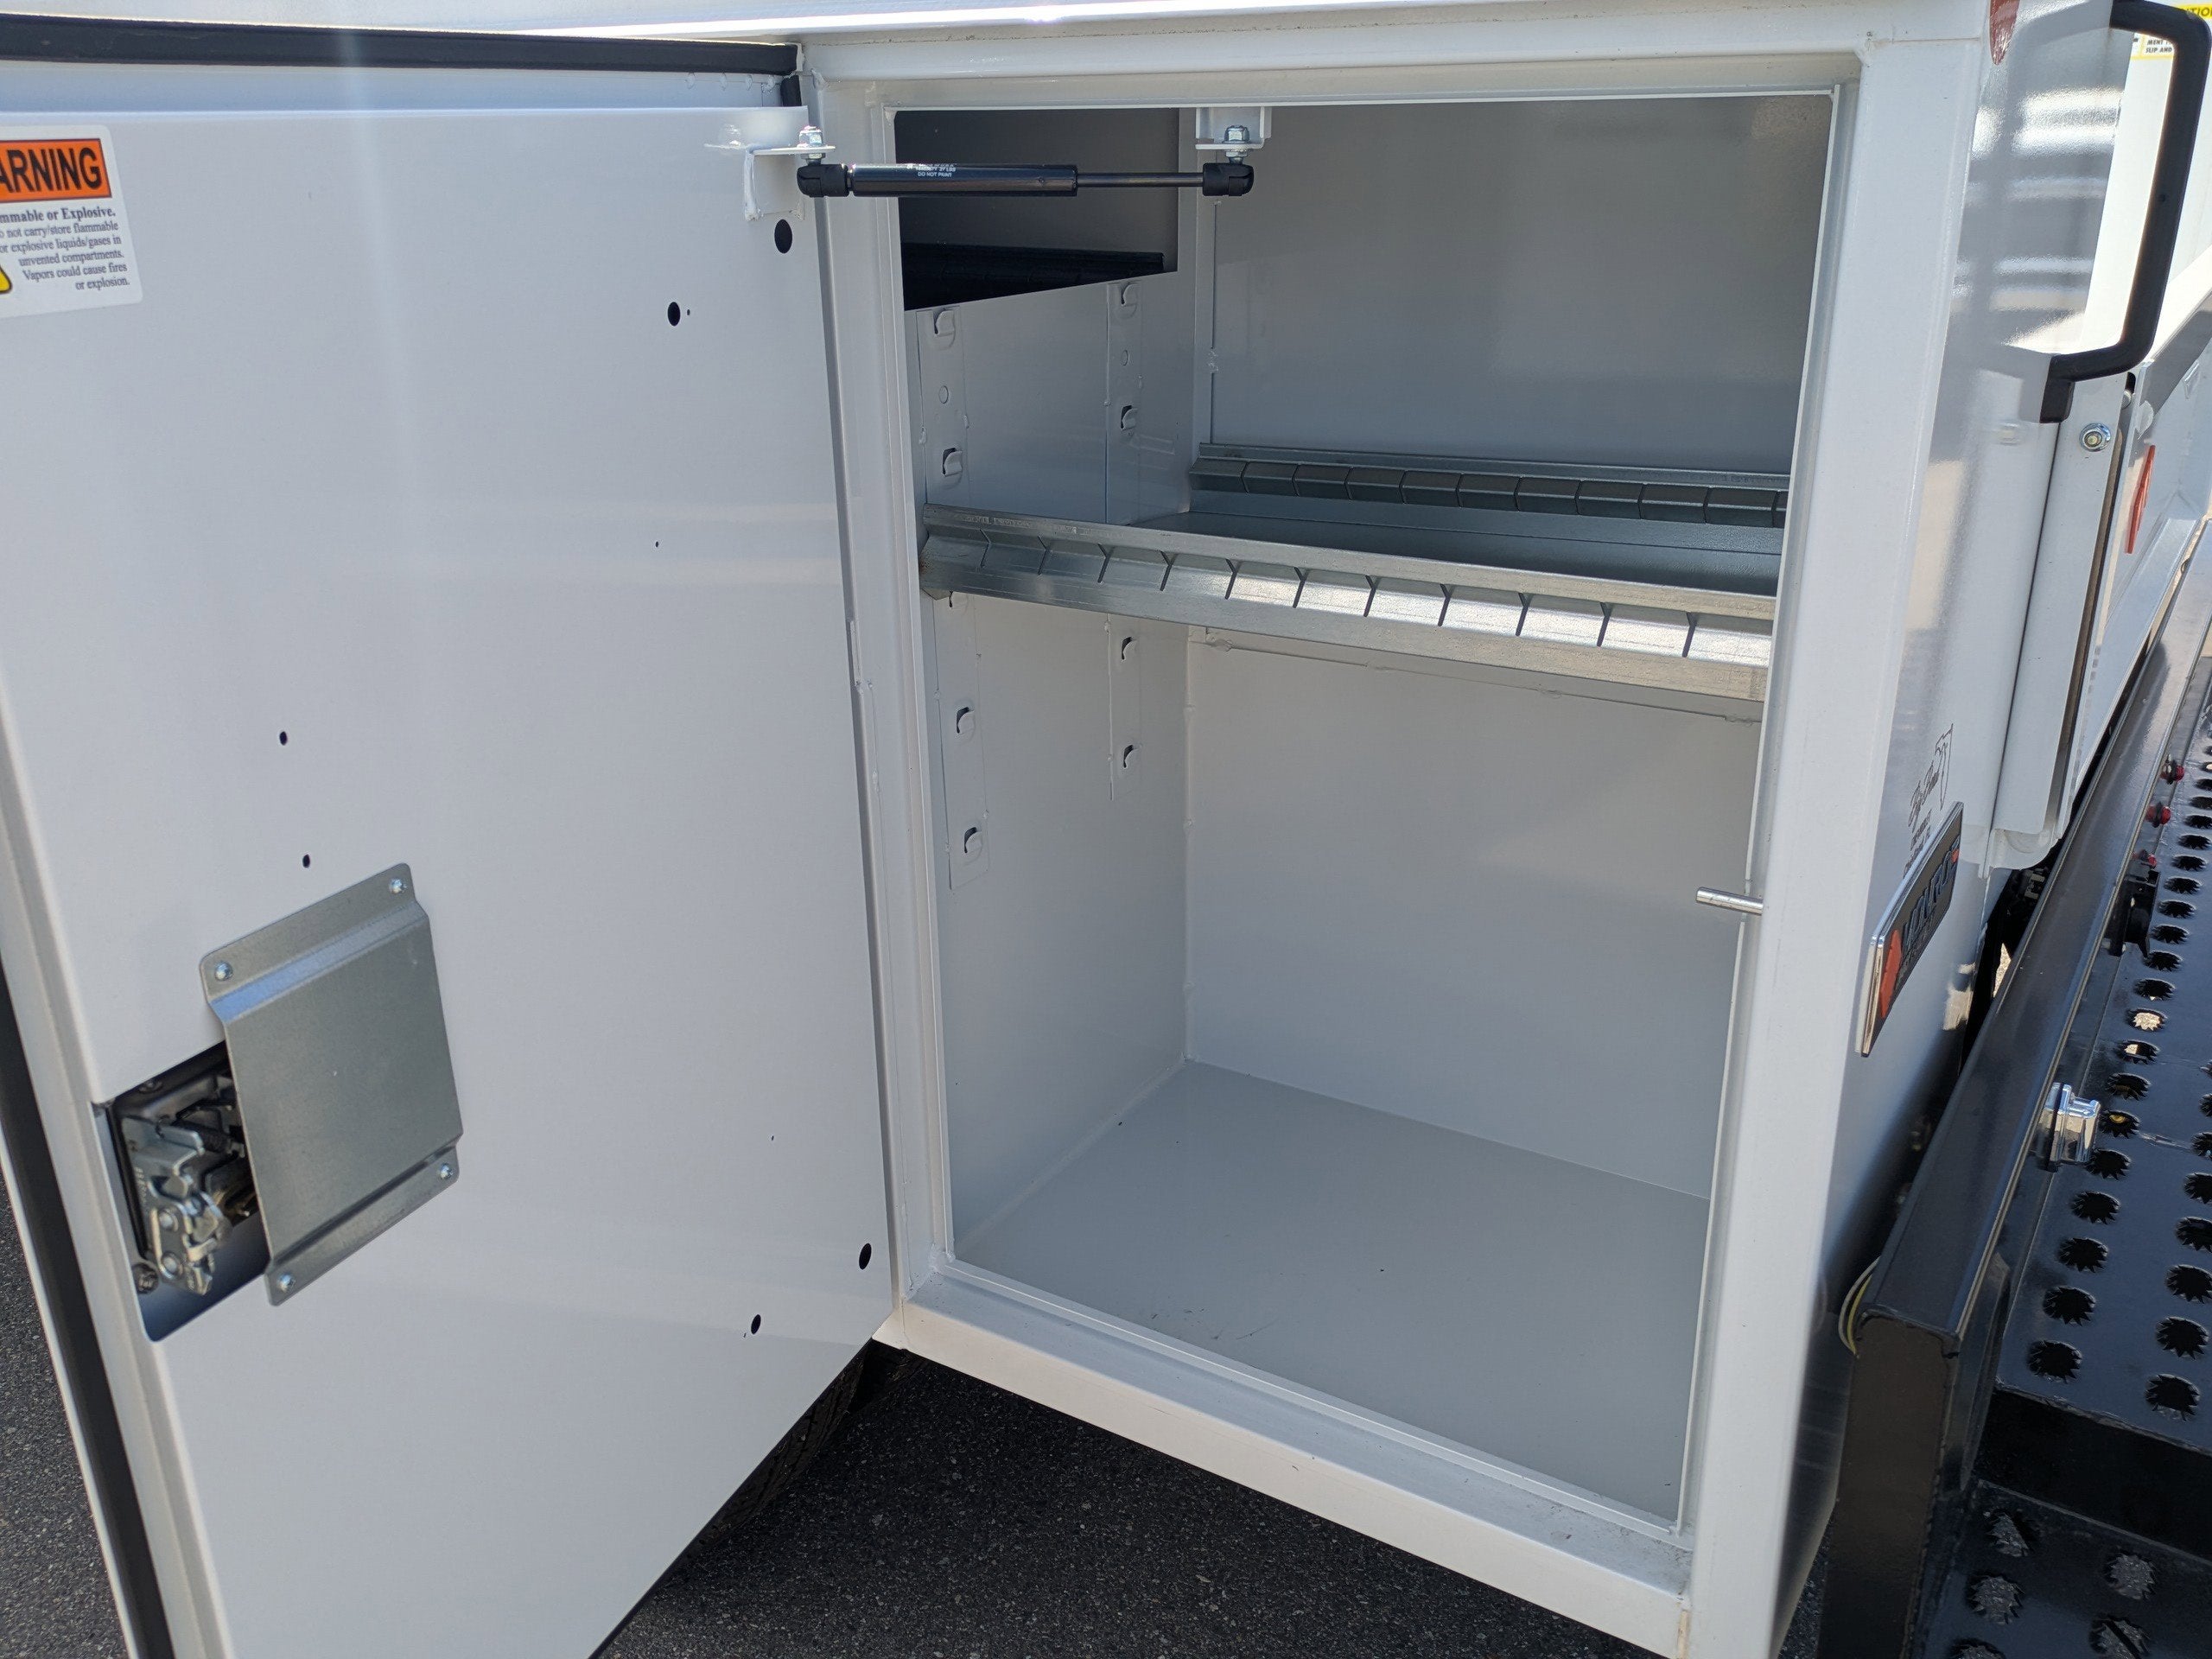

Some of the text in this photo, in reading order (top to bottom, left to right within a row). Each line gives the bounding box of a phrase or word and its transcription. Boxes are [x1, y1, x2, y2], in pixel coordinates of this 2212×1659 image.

[0, 147, 101, 193] ARNING
[0, 206, 116, 223] mmable or Explosive.
[7, 228, 22, 238] not
[73, 220, 119, 233] flammable
[11, 240, 54, 254] explosive
[112, 234, 122, 245] in
[18, 249, 124, 267] unvented compartments.
[22, 262, 128, 283] Vapors could cause fires
[75, 276, 130, 290] or explosion.
